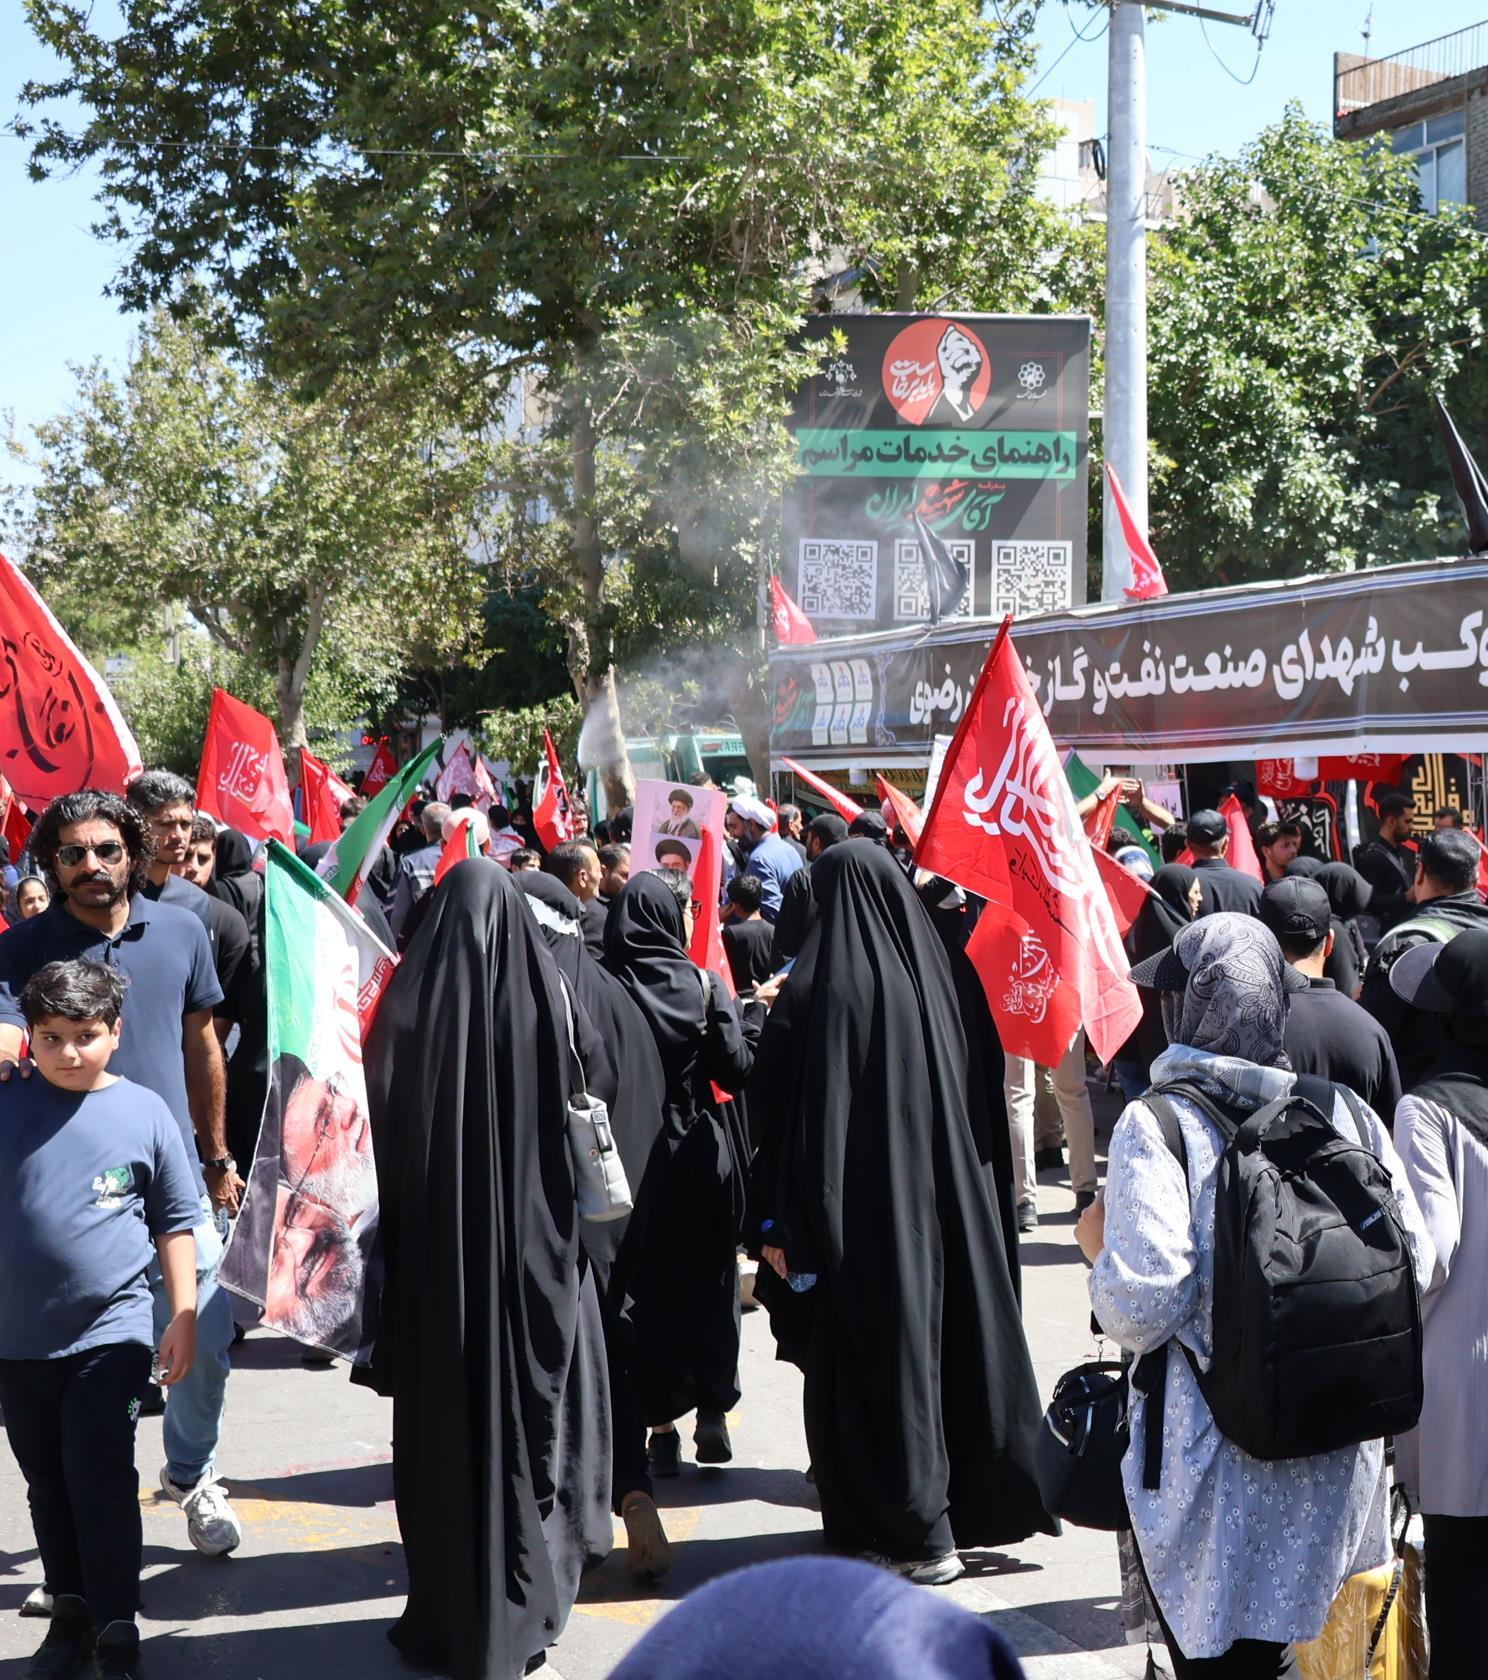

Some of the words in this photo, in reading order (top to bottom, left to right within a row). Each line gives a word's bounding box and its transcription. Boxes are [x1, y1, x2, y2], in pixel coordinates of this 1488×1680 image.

[801, 433, 874, 472] مراسم
[877, 435, 969, 464] خدمات
[970, 435, 1071, 474] راهنمای
[1043, 646, 1089, 717] گاز
[1104, 640, 1167, 698] نفت
[1169, 644, 1267, 693] صنعت
[1272, 615, 1385, 700] شهدای
[909, 663, 962, 724] رضوی
[1092, 668, 1108, 715] و
